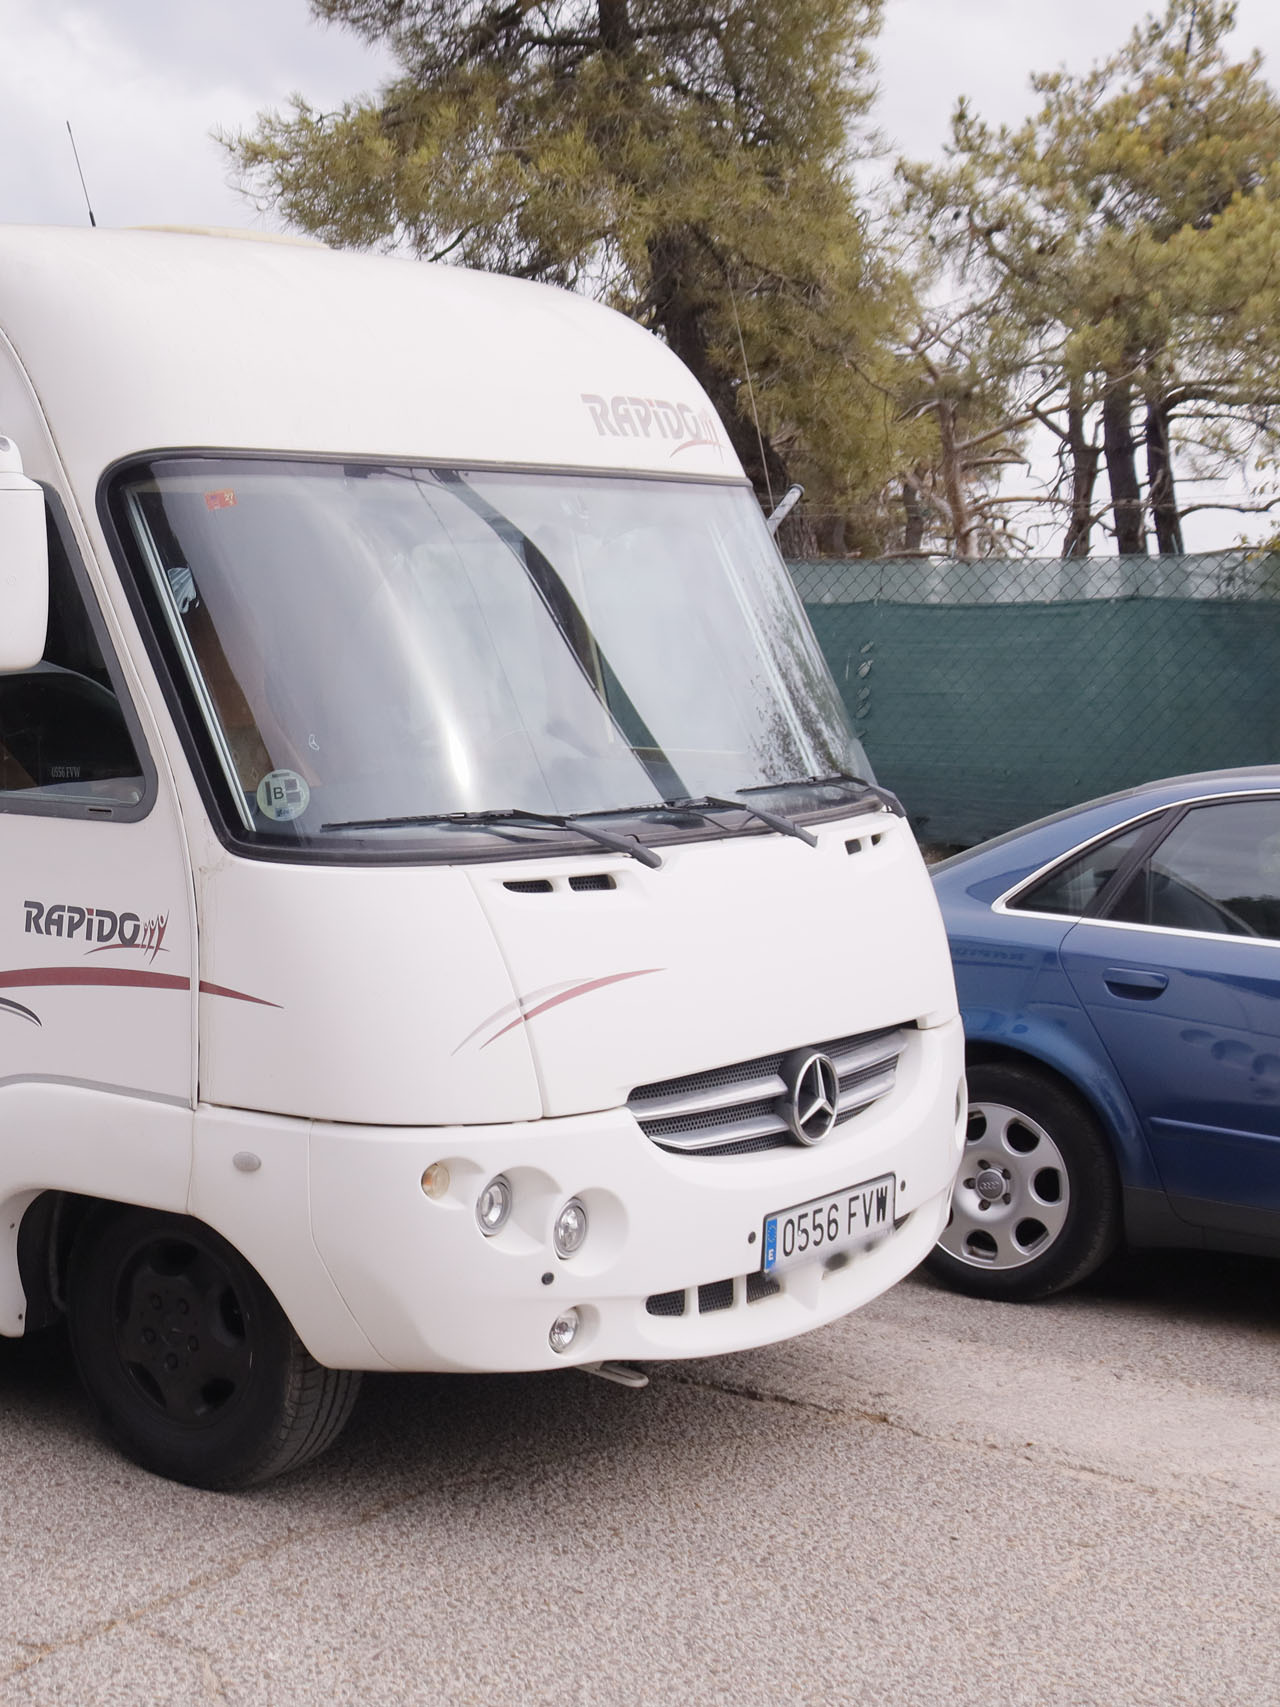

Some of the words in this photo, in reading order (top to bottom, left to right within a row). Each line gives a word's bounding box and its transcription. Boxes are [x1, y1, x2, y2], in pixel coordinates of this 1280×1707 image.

[273, 787, 284, 799] B
[783, 1203, 839, 1257] 0556
[848, 1186, 888, 1235] FVW
[767, 1248, 775, 1261] E
